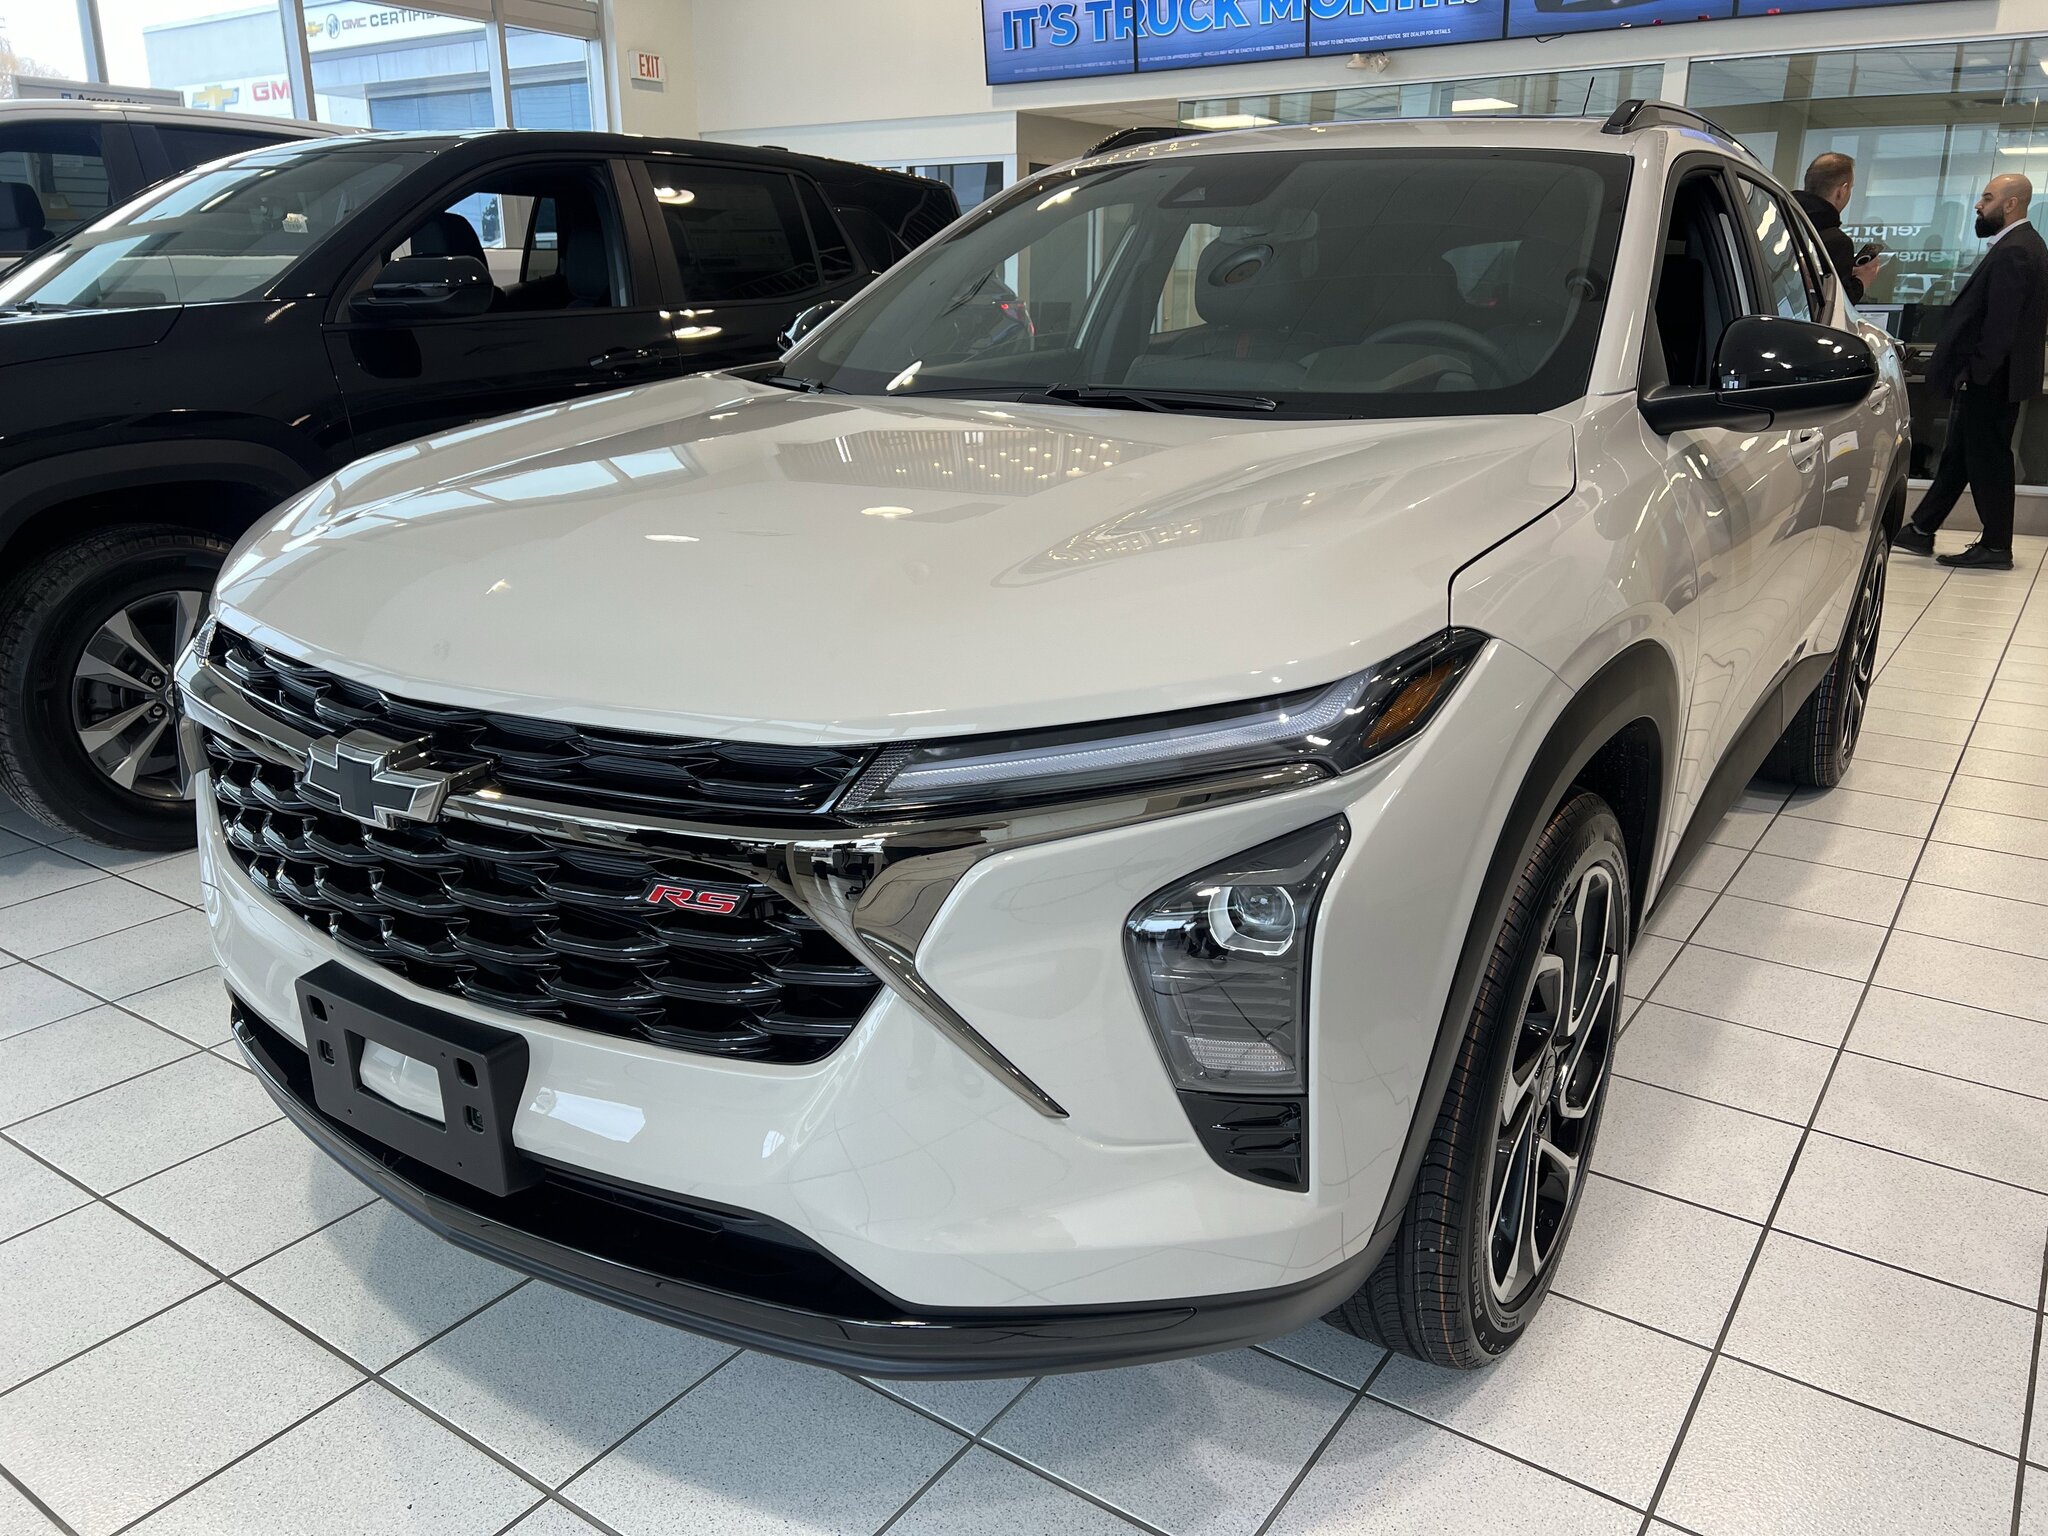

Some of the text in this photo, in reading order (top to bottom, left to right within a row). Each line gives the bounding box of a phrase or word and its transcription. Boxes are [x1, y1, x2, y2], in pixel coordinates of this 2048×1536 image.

[342, 17, 367, 30] GMC
[1002, 3, 1079, 51] IT'S
[1085, 0, 1251, 42] TRUCK
[639, 53, 660, 78] EXIT
[252, 80, 290, 102] GM
[646, 884, 740, 914] RS
